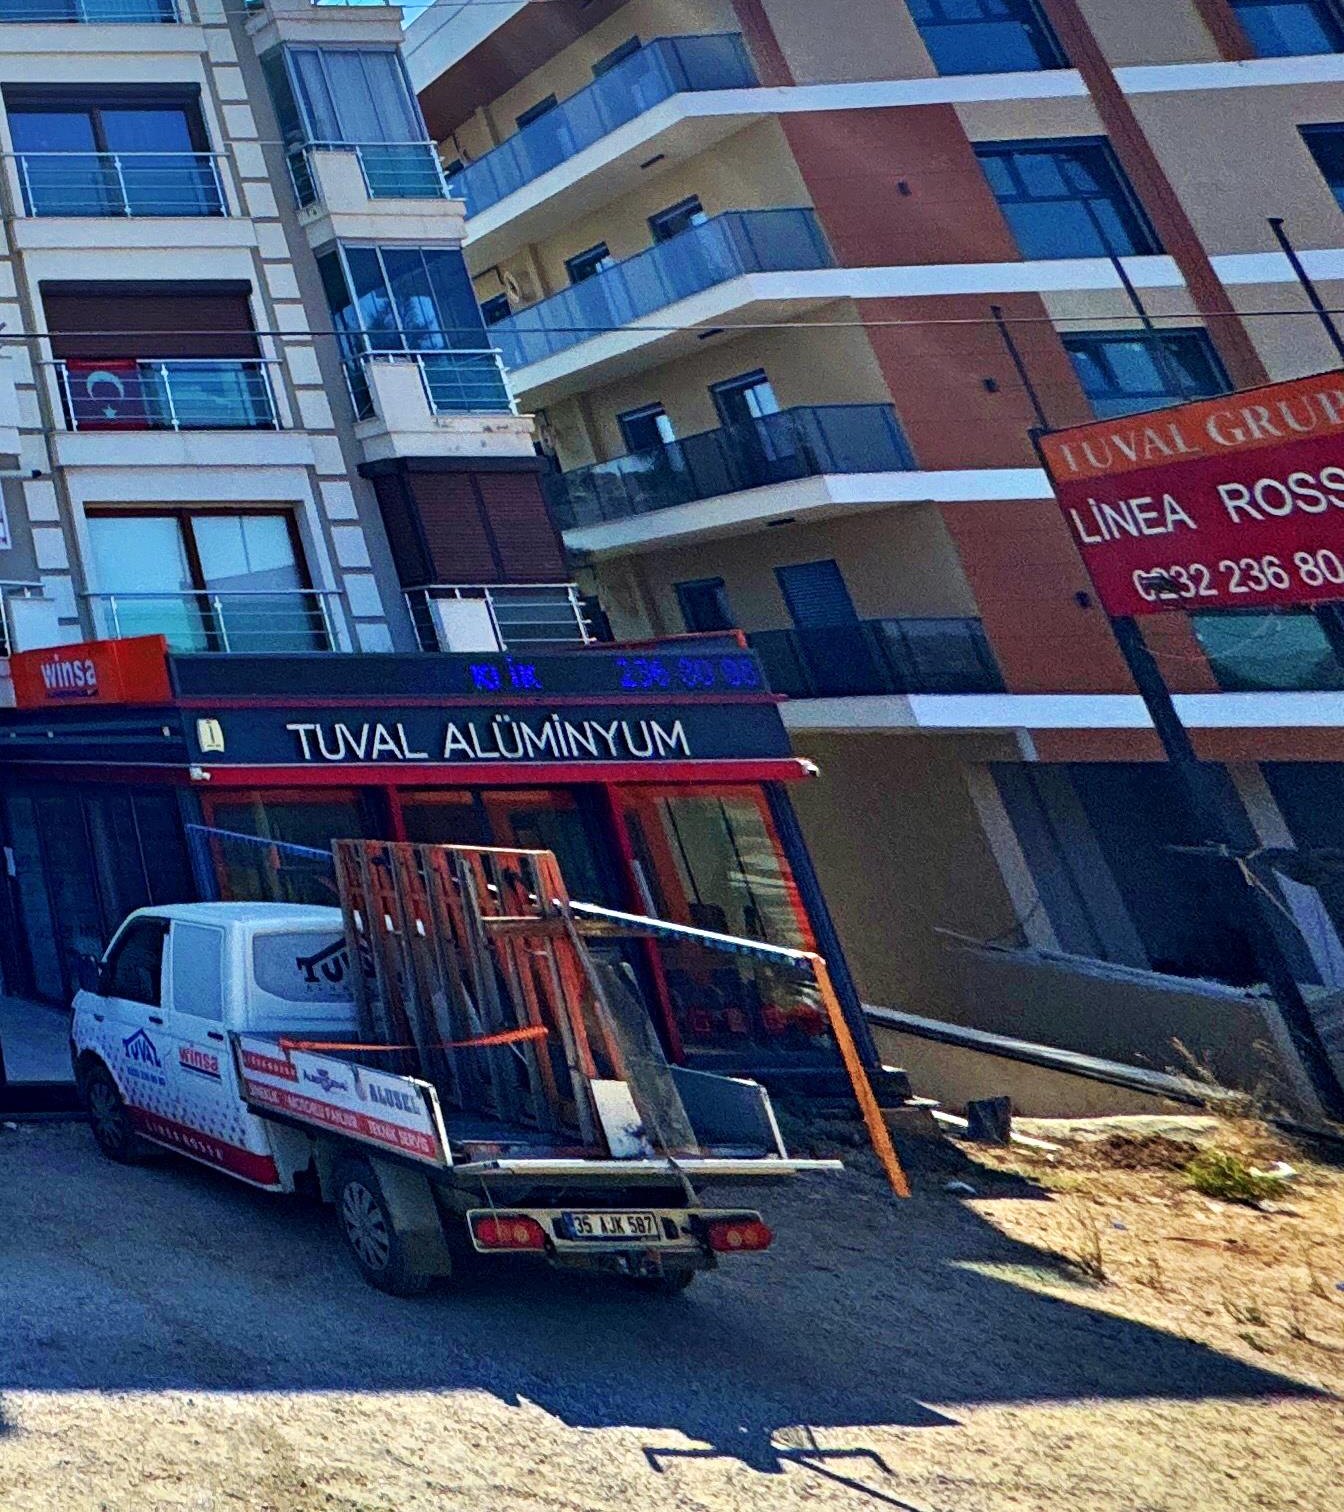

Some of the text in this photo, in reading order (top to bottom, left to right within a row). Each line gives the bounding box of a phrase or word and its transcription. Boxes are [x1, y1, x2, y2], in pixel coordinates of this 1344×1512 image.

[1059, 423, 1201, 473] TUVAL
[1219, 555, 1290, 595] 236
[40, 654, 97, 689] winsa
[286, 713, 692, 760] TUVAL ALÜMİNYUM
[574, 1215, 594, 1234] 35
